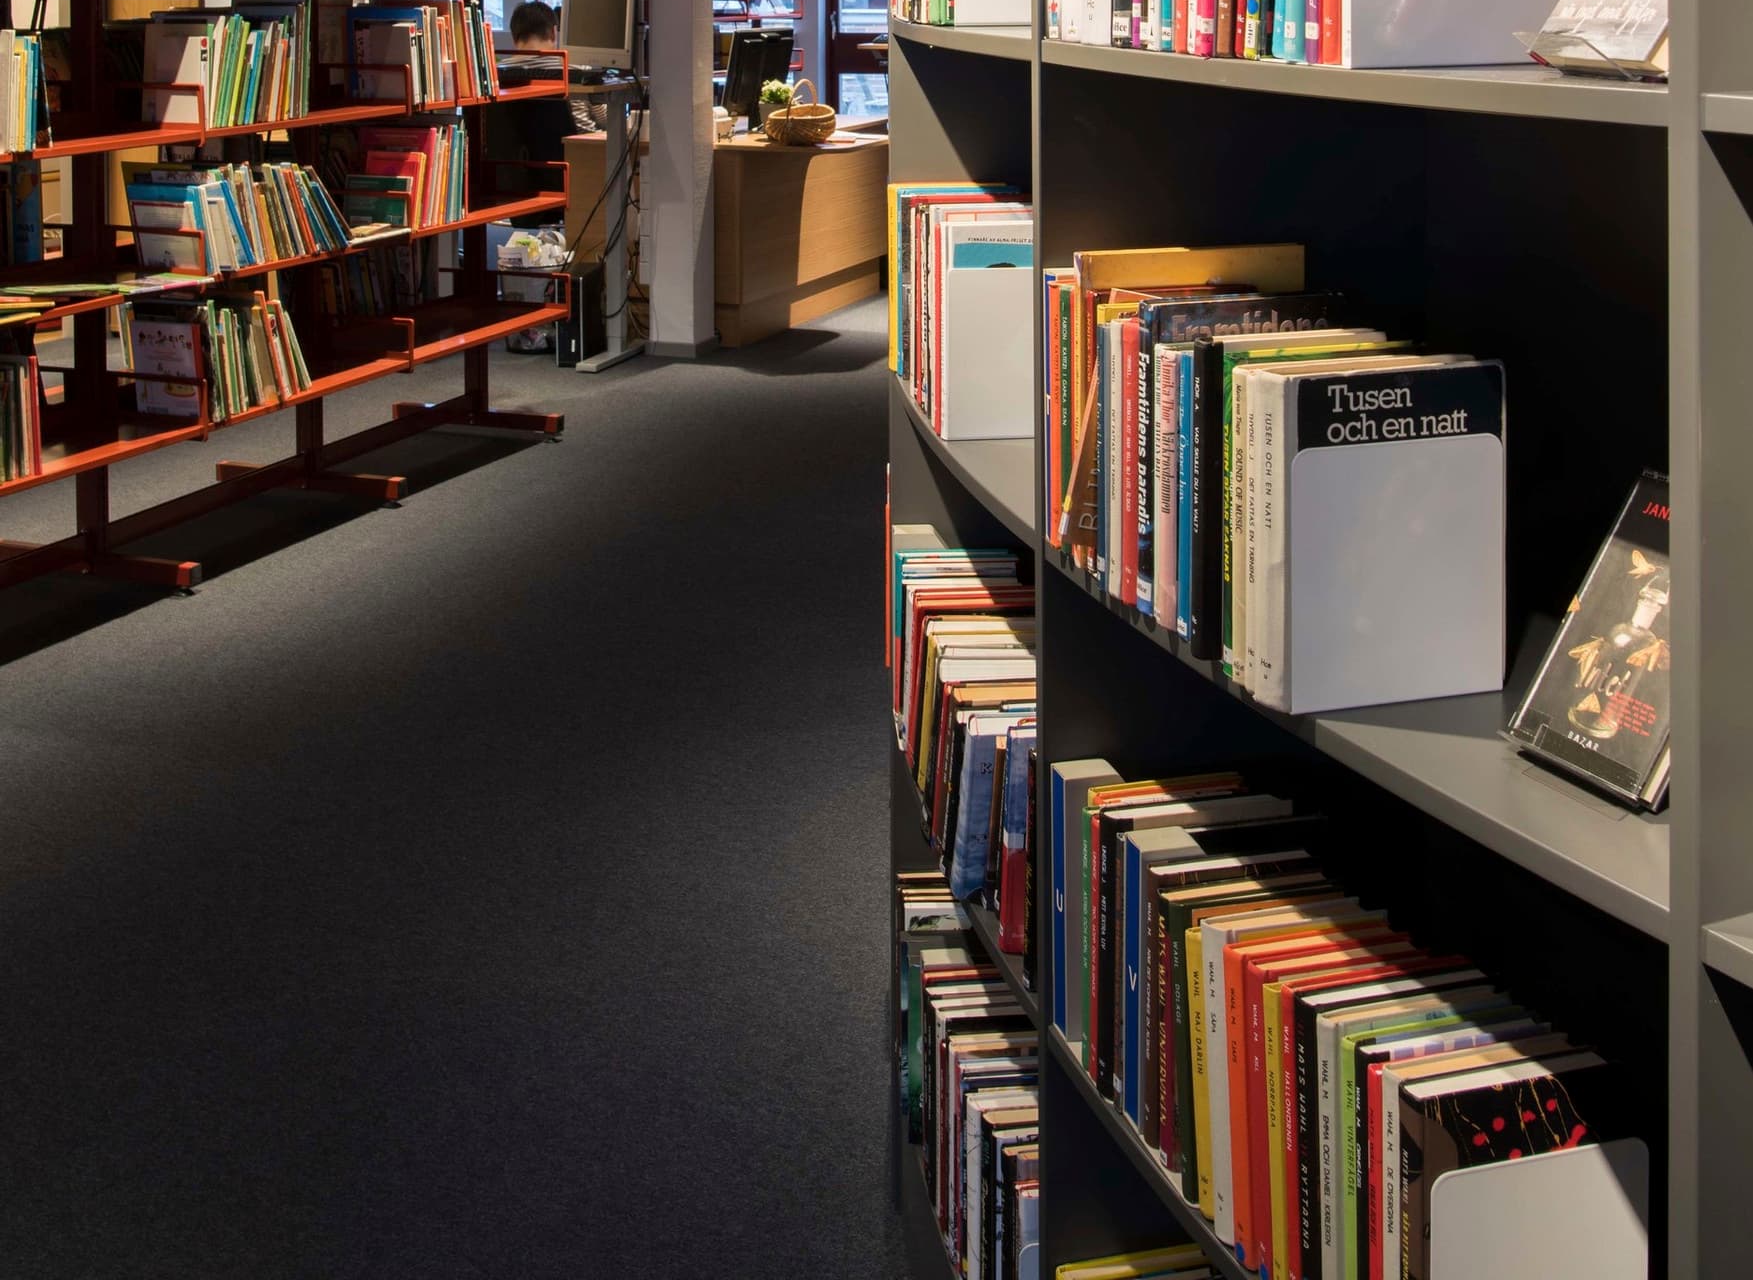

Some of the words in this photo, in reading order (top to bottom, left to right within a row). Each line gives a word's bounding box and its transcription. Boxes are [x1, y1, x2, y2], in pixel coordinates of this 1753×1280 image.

[1138, 352, 1150, 458] Framtidens
[1327, 383, 1412, 413] Tusen
[1265, 412, 1273, 446] TUSEN
[1327, 413, 1378, 443] och
[1382, 418, 1417, 439] en
[1420, 409, 1467, 435] natt
[1235, 447, 1244, 483] SOUND
[1265, 452, 1273, 477] OCH
[1138, 462, 1150, 535] paradis
[1194, 477, 1200, 490] DU
[1235, 487, 1243, 501] OF
[1265, 482, 1273, 496] EN
[1235, 504, 1243, 535] MUSIC
[1265, 502, 1273, 530] NATT
[1248, 530, 1255, 542] EN
[1567, 730, 1600, 752] BAZAR
[1195, 1036, 1203, 1075] DARLIN
[1298, 1043, 1306, 1085] MATS
[1268, 1070, 1276, 1129] NORRPADA
[1298, 1093, 1307, 1134] WAHL
[1347, 1125, 1356, 1197] VINTERFÅGEL
[1386, 1166, 1393, 1179] DE
[1323, 1167, 1331, 1196] DANIEL
[1300, 1163, 1309, 1249] RYTTARNA
